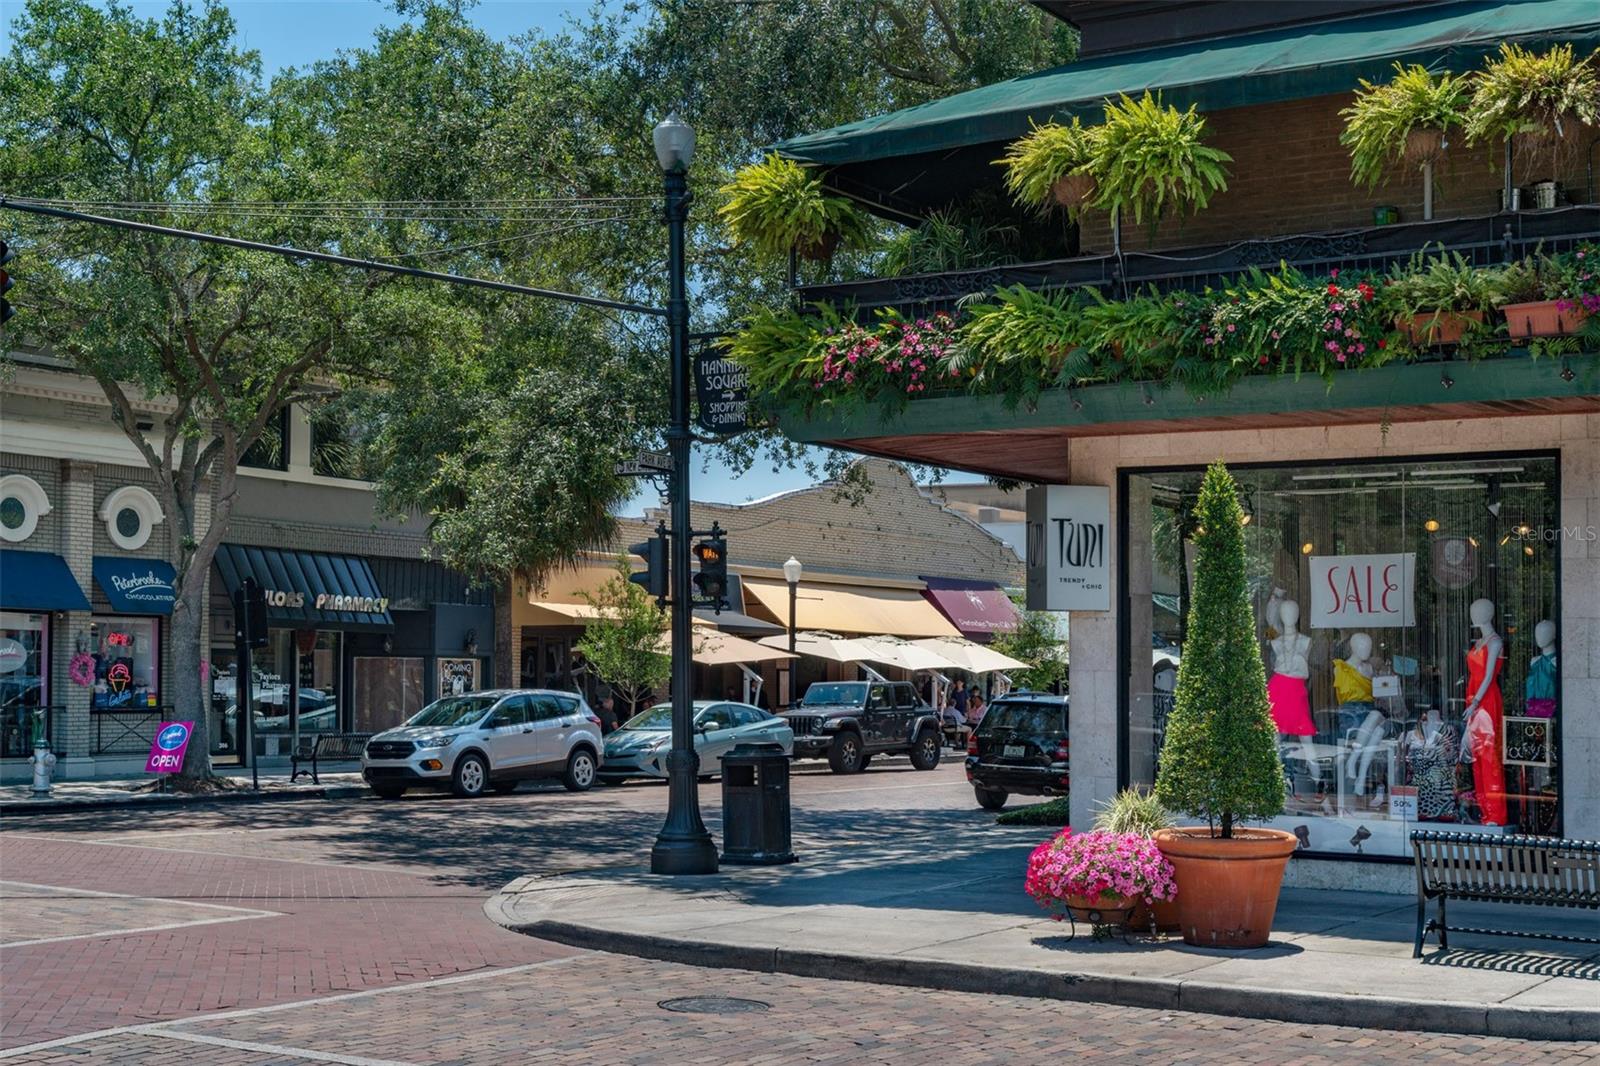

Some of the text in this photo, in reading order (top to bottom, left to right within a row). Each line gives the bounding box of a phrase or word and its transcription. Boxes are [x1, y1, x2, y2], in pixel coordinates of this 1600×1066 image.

[705, 373, 749, 390] SQUARE
[641, 452, 655, 465] PARK
[1327, 564, 1399, 614] SALE
[316, 593, 389, 613] PHARMACY
[444, 664, 471, 672] COMING
[151, 755, 180, 767] OPEN
